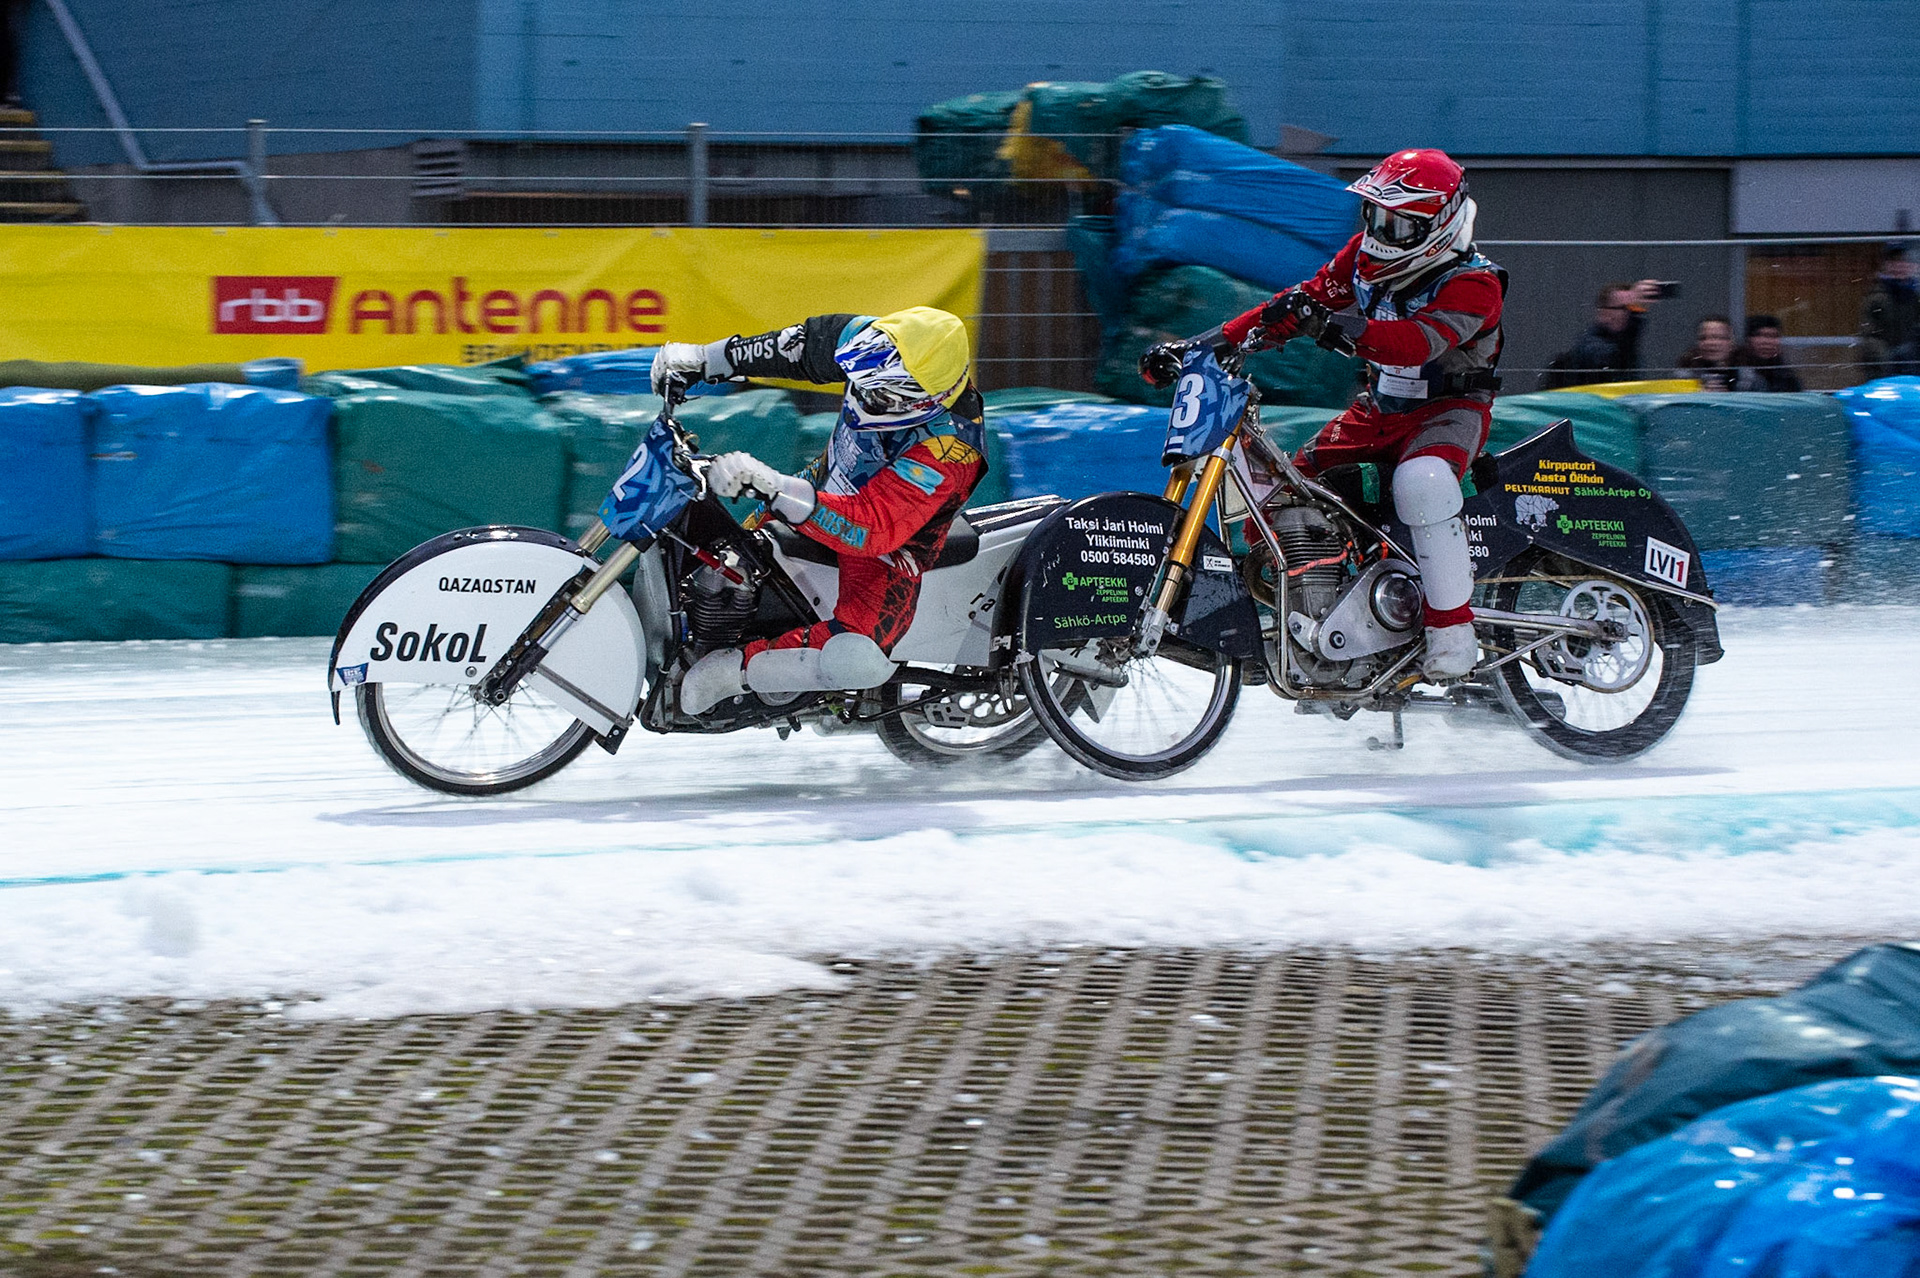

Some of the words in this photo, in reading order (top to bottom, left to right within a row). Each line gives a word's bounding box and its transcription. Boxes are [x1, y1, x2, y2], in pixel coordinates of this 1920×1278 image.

[218, 288, 326, 324] rbb
[348, 276, 668, 334] Antenne
[1172, 373, 1204, 429] 3
[612, 442, 648, 502] 2
[1538, 459, 1596, 472] Kirpputori
[1533, 472, 1567, 483] Aasta
[1573, 486, 1636, 499] Sähkö-Artpe
[1638, 488, 1652, 500] Oy
[1065, 517, 1100, 532] Taksi
[1102, 518, 1126, 532] Jari
[1128, 520, 1164, 535] Holmi
[1574, 519, 1625, 532] APTEEKKI
[1085, 533, 1150, 550] Ylikiiminki
[1080, 550, 1110, 564] 0500
[1112, 551, 1156, 567] 584580
[438, 576, 537, 595] QAZAQSTAN
[1080, 576, 1128, 588] APTEEKKI
[1053, 613, 1128, 630] Sähkö-Artpe
